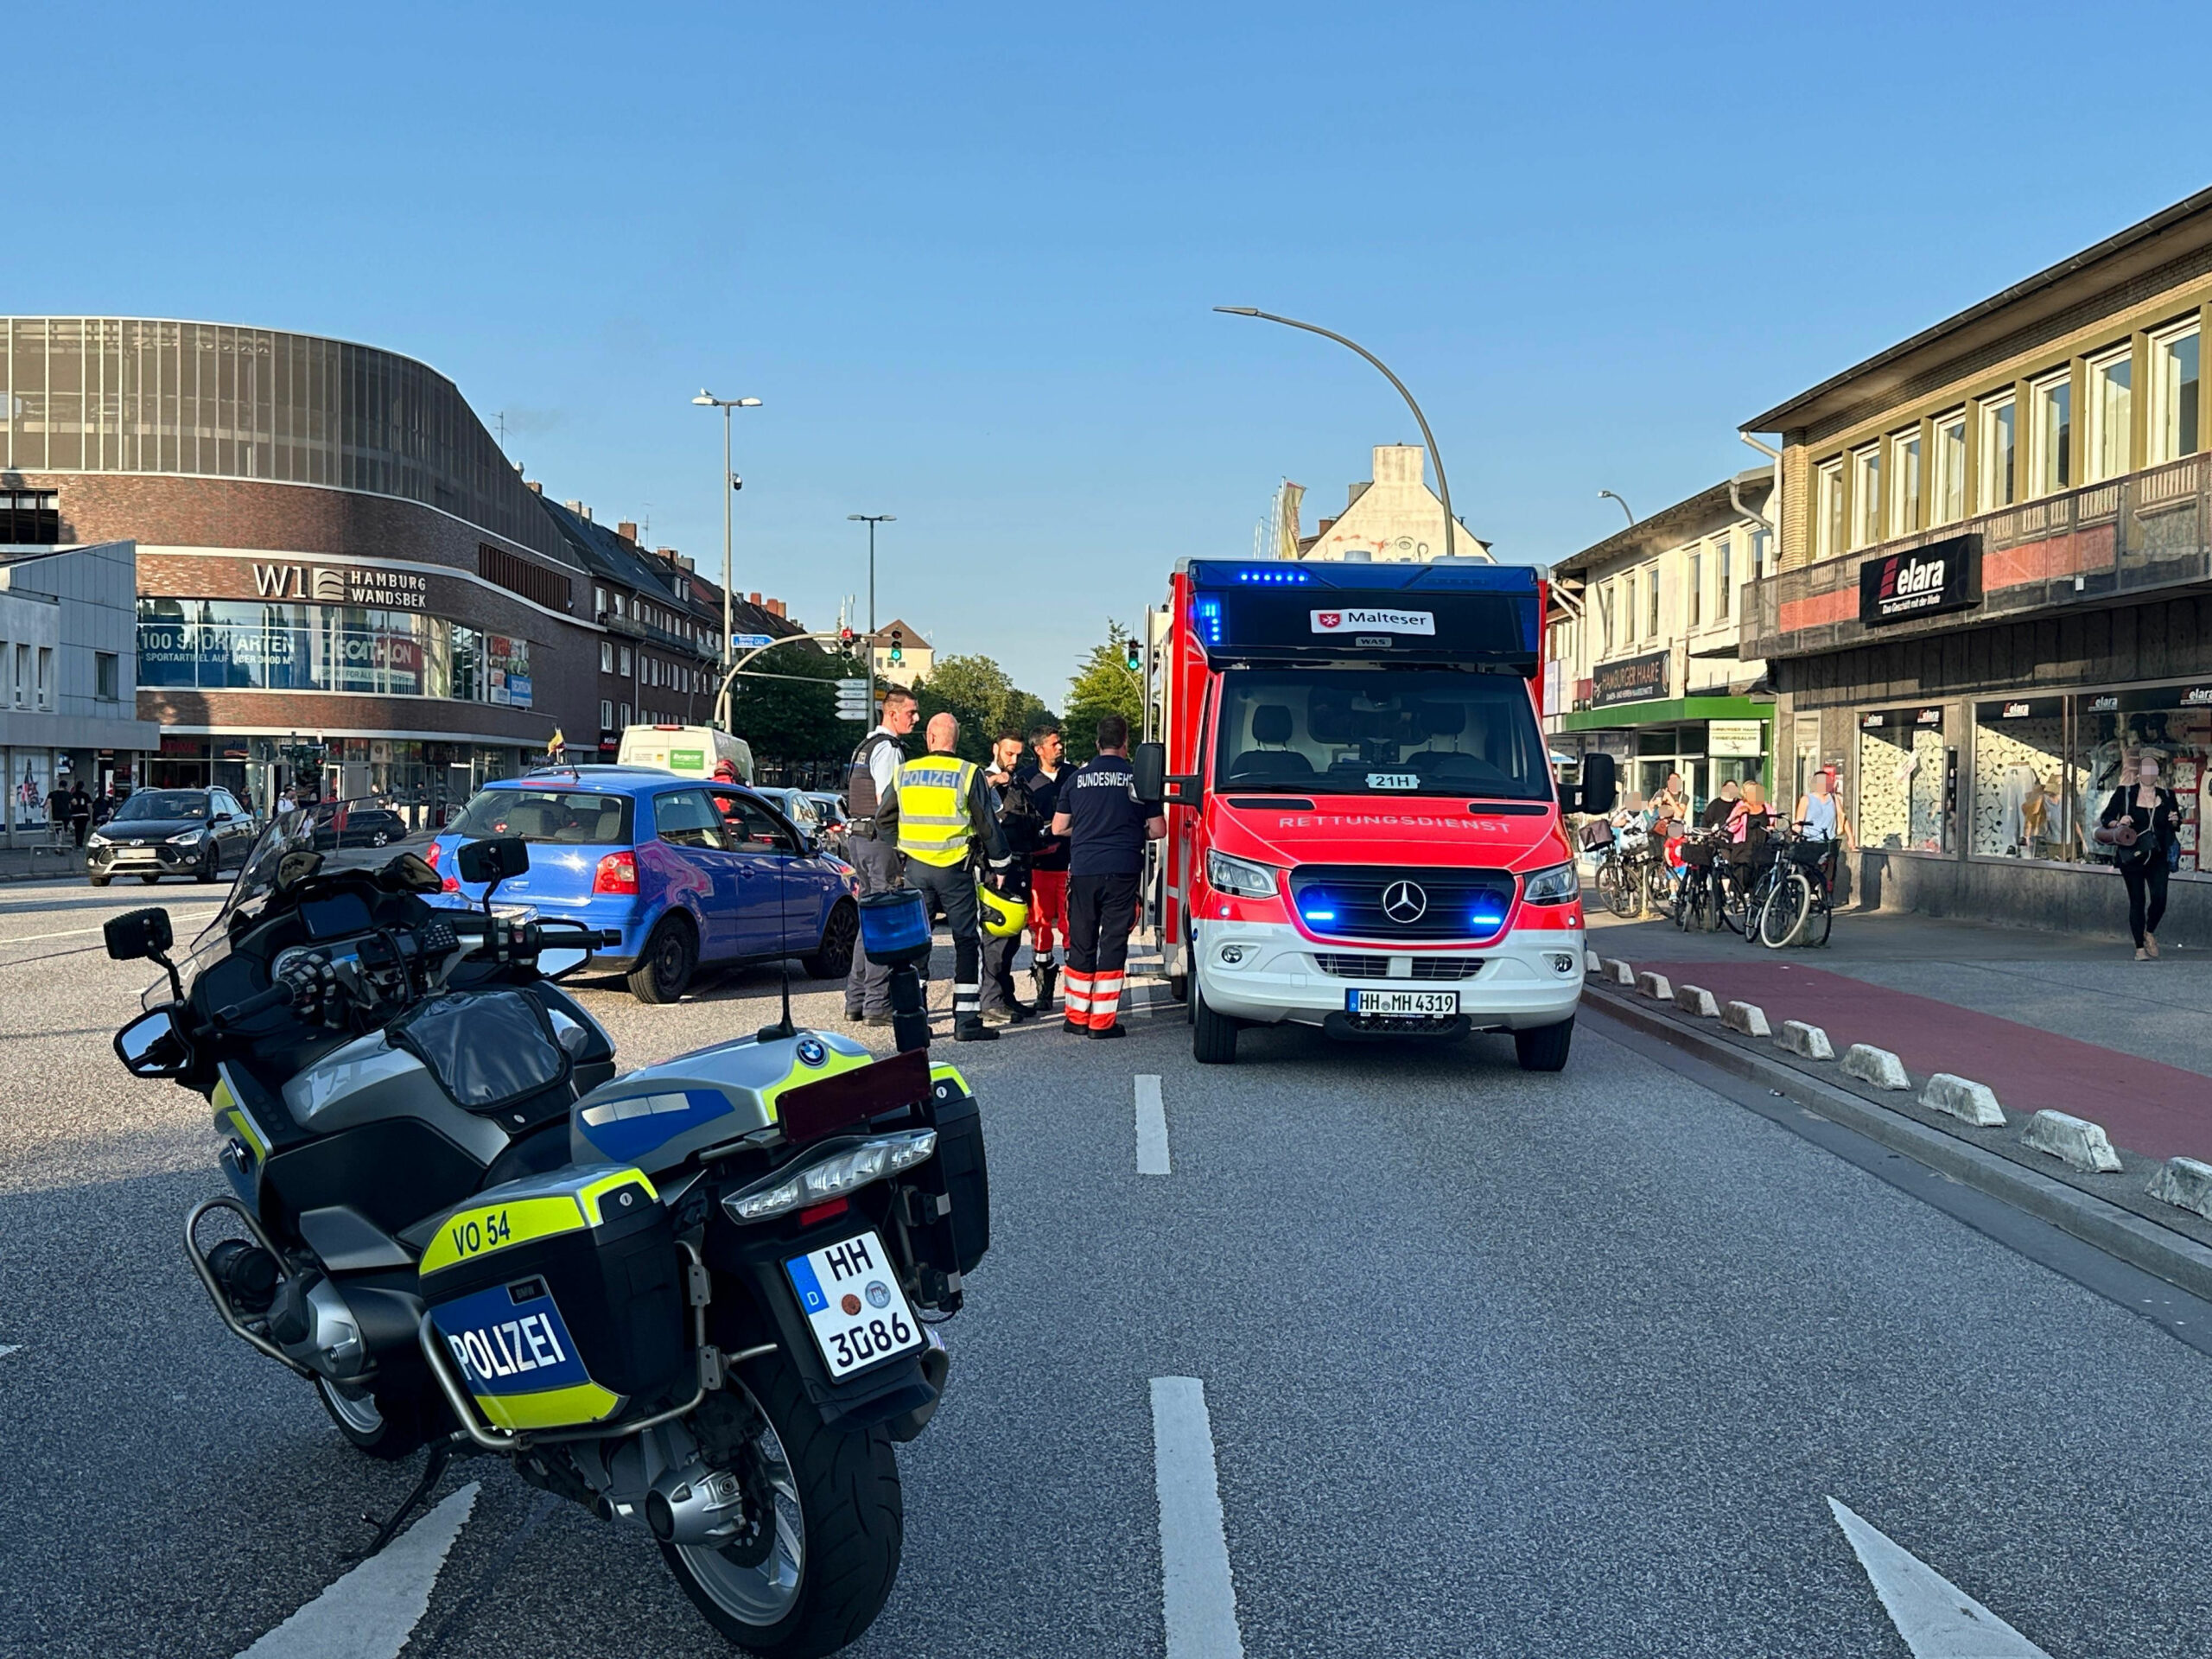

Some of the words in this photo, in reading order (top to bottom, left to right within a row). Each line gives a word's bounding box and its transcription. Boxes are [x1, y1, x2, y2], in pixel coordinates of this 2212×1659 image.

[252, 563, 307, 599] W1
[351, 570, 427, 591] HAMBURG
[1897, 557, 1945, 595] elara
[351, 588, 427, 608] WANDSBEK
[1348, 612, 1427, 625] Malteser
[141, 632, 172, 650] 100
[176, 632, 295, 653] SPORTARTEN
[322, 639, 412, 664] DECATHLON
[211, 653, 230, 663] AUF
[346, 670, 359, 678] FOR
[1602, 665, 1637, 690] HAMBURGER
[1637, 661, 1660, 685] HAARE
[2009, 703, 2030, 714] elara
[2095, 696, 2118, 707] elara
[901, 769, 958, 788] POLIZEI
[1375, 776, 1410, 787] 21H
[1279, 816, 1510, 834] RETTUNGSDIENST
[1359, 993, 1379, 1011] HH
[1391, 995, 1412, 1011] MH
[1415, 995, 1453, 1012] 4319
[452, 1221, 480, 1256] VO
[486, 1210, 511, 1246] 54
[824, 1238, 874, 1281] HH
[806, 1291, 820, 1306] D
[447, 1313, 567, 1381] POLIZEI
[829, 1312, 911, 1368] 3086
